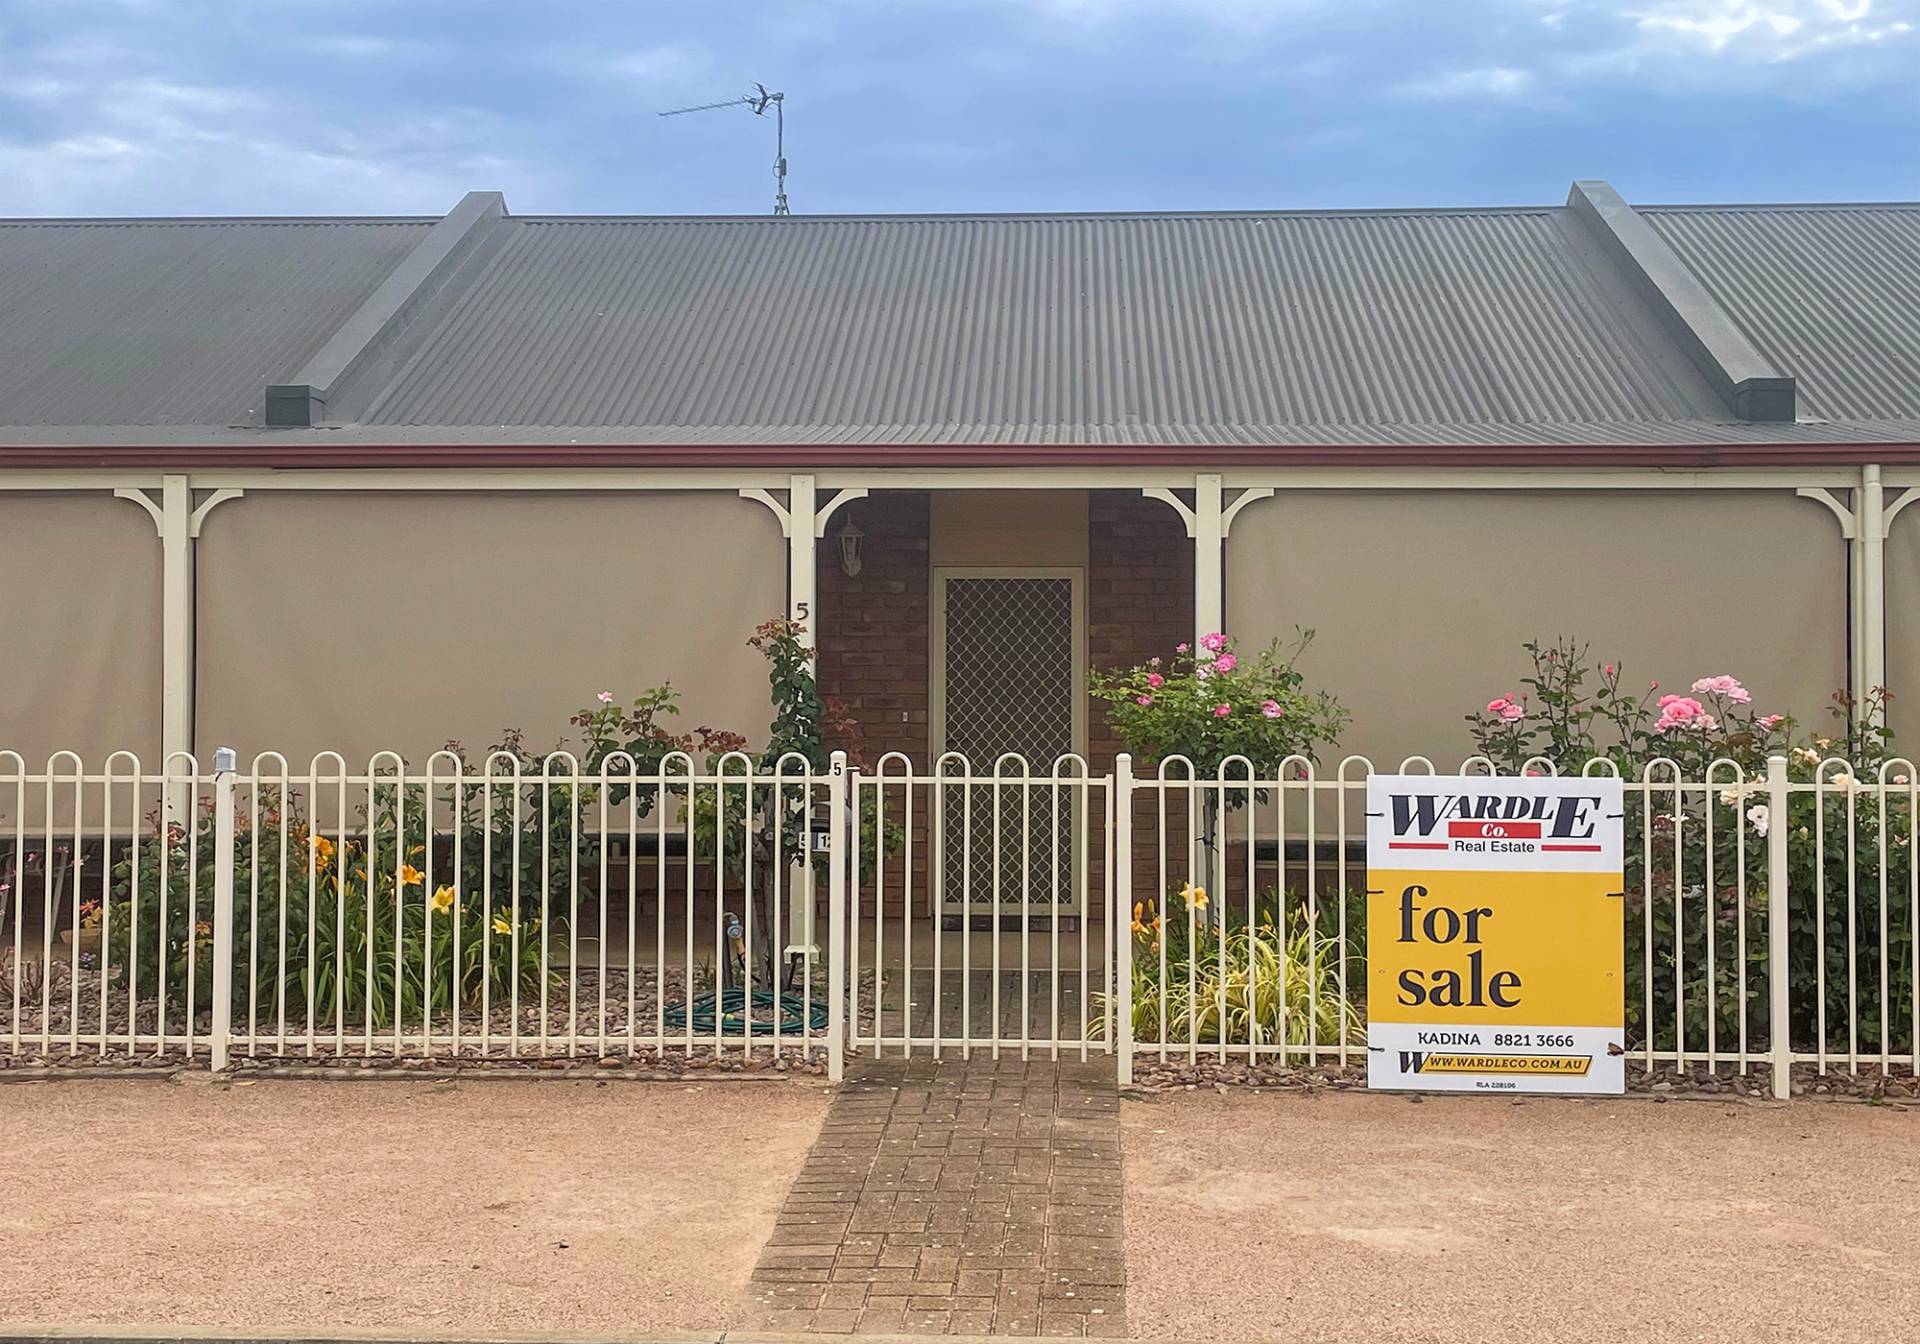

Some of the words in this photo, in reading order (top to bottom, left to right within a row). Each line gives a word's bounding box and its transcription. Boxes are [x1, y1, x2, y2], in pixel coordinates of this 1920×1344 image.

[796, 602, 809, 621] 5
[833, 762, 842, 776] 5
[1388, 794, 1601, 839] WARDLE
[1481, 823, 1509, 838] Co.
[1454, 840, 1486, 852] Real
[1491, 841, 1535, 853] Estate
[1397, 885, 1493, 944] for
[1397, 949, 1522, 1008] sale
[1418, 1032, 1481, 1046] KADINA
[1494, 1034, 1531, 1047] 8821
[1536, 1034, 1574, 1048] 3666
